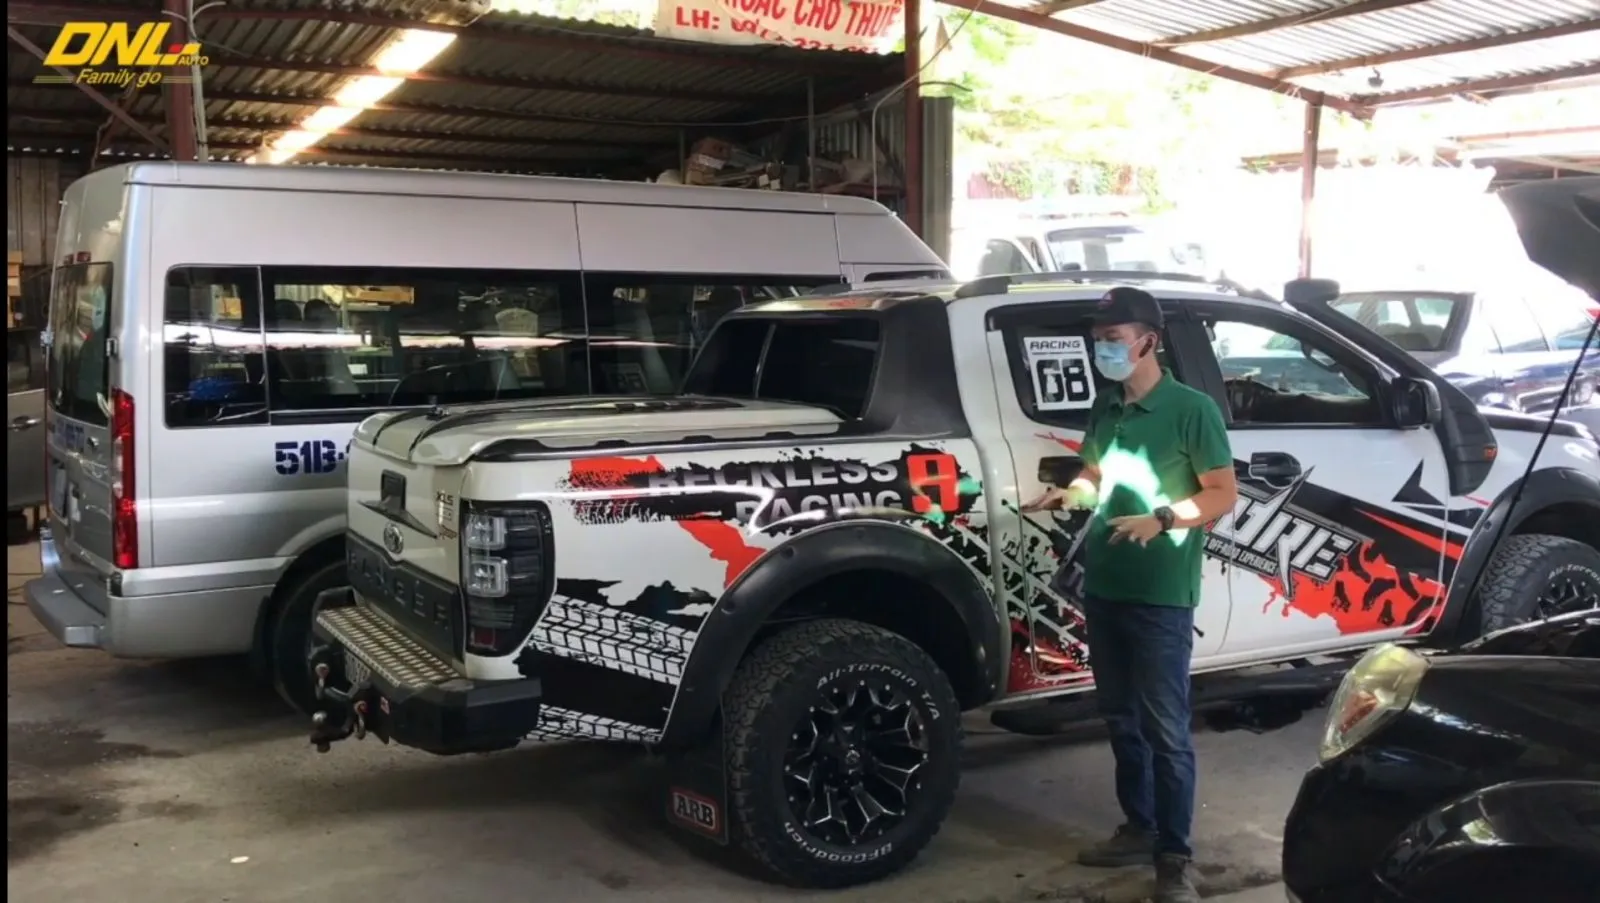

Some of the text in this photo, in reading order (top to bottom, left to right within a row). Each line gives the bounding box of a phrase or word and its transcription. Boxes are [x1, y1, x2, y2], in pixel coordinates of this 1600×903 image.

[675, 6, 720, 30] LH:
[794, 0, 842, 31] CHO
[1029, 340, 1081, 350] RACING
[1036, 358, 1091, 403] 68
[275, 439, 351, 476] 51B-
[648, 460, 898, 490] RECKLESS
[735, 490, 904, 522] RACING
[816, 663, 941, 720] All-Terrain T/A
[674, 794, 714, 828] ARB
[784, 821, 893, 863] BFGoodrich
